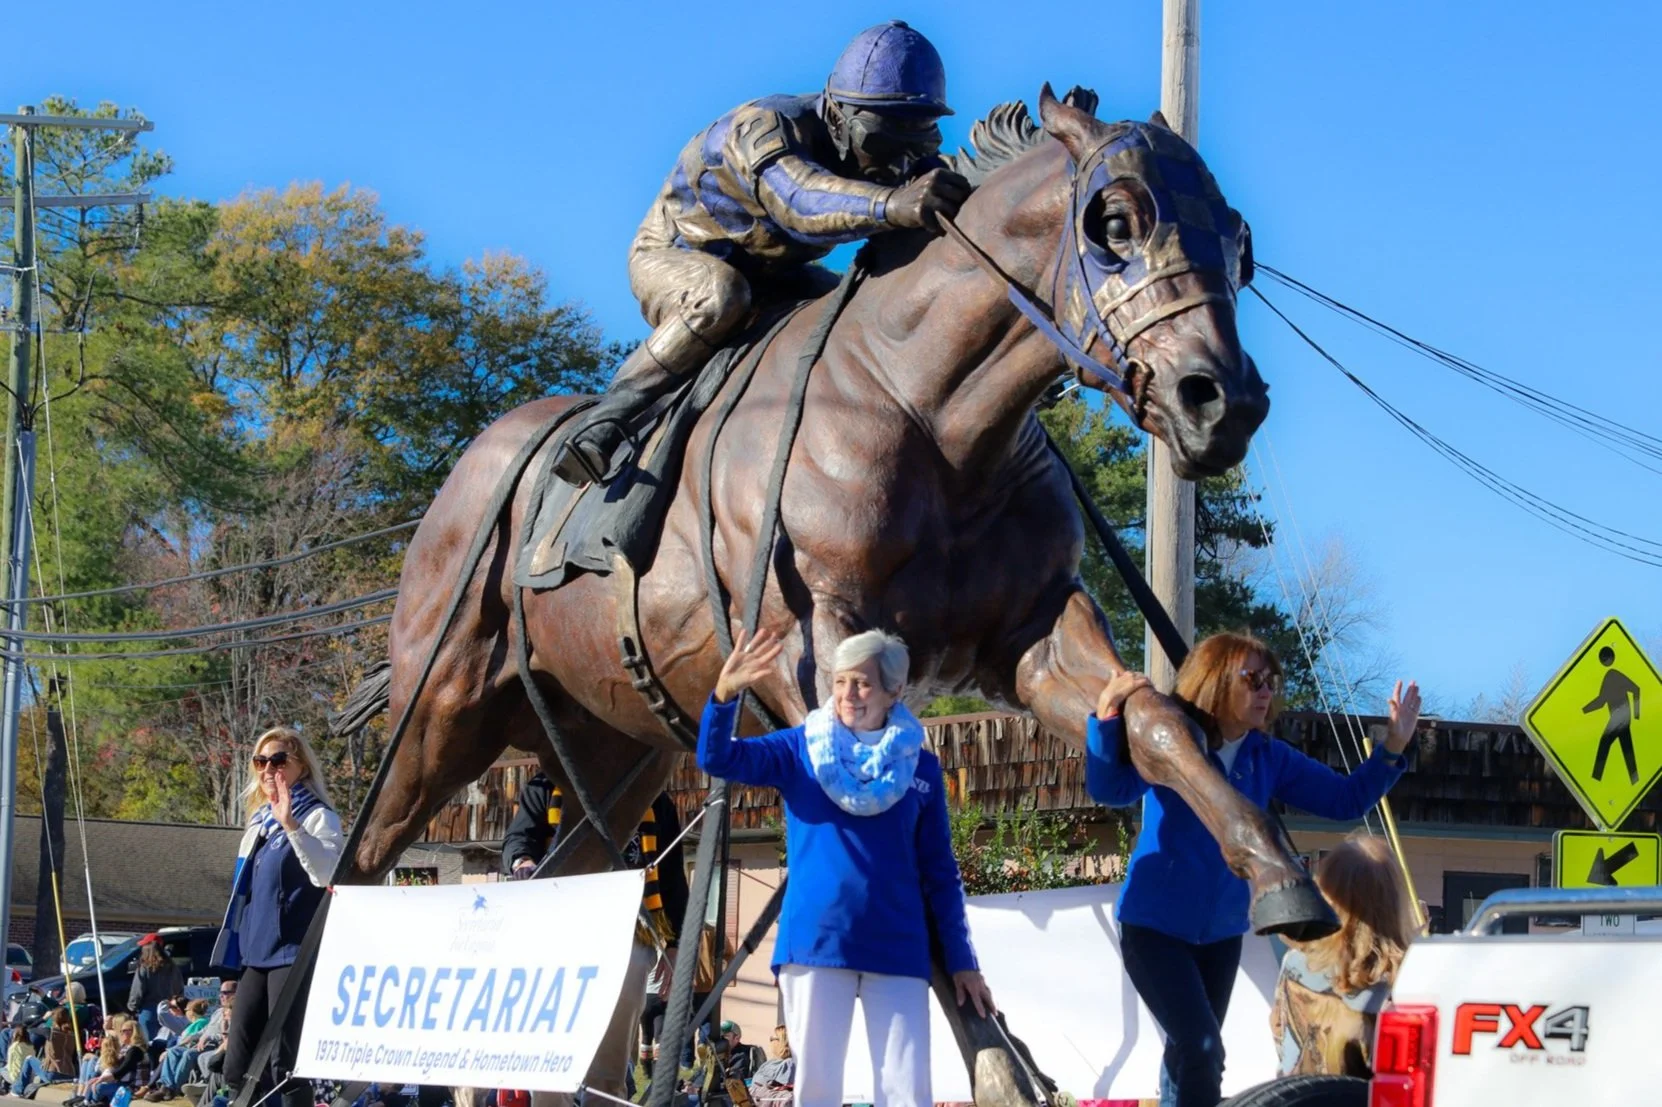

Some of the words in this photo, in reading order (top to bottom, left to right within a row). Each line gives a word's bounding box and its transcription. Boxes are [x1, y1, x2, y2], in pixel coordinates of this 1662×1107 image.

[1600, 913, 1620, 927] TWO
[332, 965, 599, 1032] SECRETARIAT
[1452, 1002, 1591, 1055] FX4
[315, 1040, 339, 1061] 1973
[341, 1042, 373, 1069] Triple
[375, 1044, 412, 1066] Crown
[413, 1047, 459, 1075] Legend
[460, 1049, 470, 1069] &
[471, 1050, 541, 1071] Hometown
[542, 1052, 573, 1073] Hero
